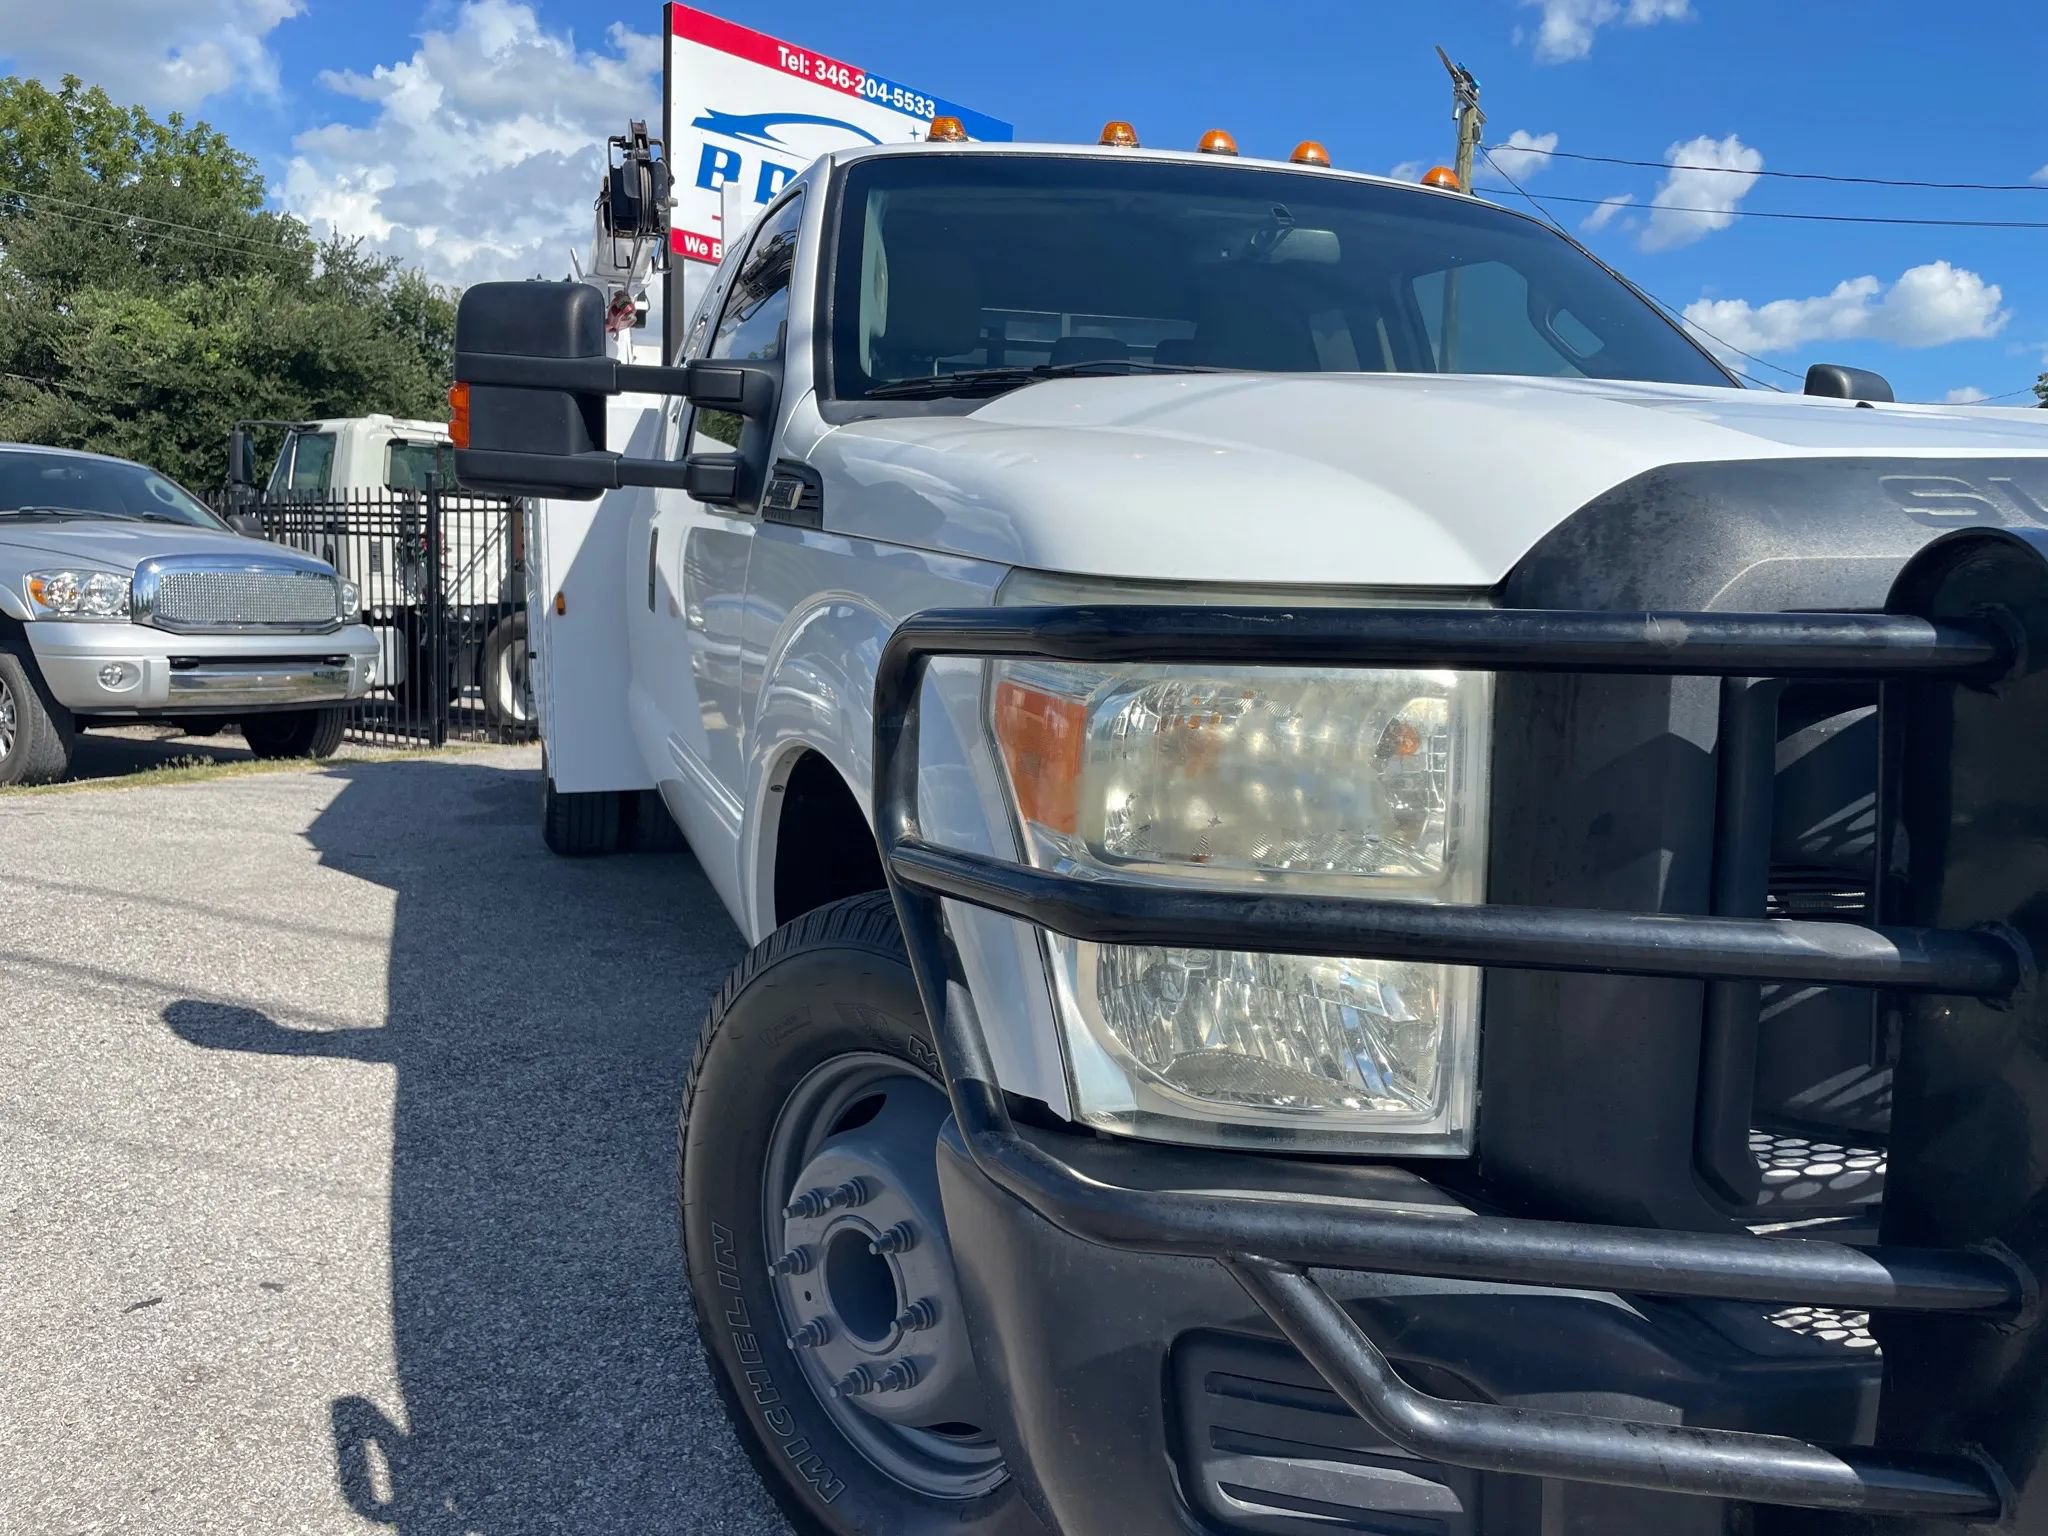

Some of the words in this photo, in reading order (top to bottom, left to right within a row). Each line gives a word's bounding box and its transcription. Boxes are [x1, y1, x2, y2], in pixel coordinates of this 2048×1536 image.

[778, 45, 810, 75] Tel:
[815, 60, 935, 118] 346-204-5533
[684, 235, 708, 255] We
[711, 1222, 847, 1503] MICHELIN
